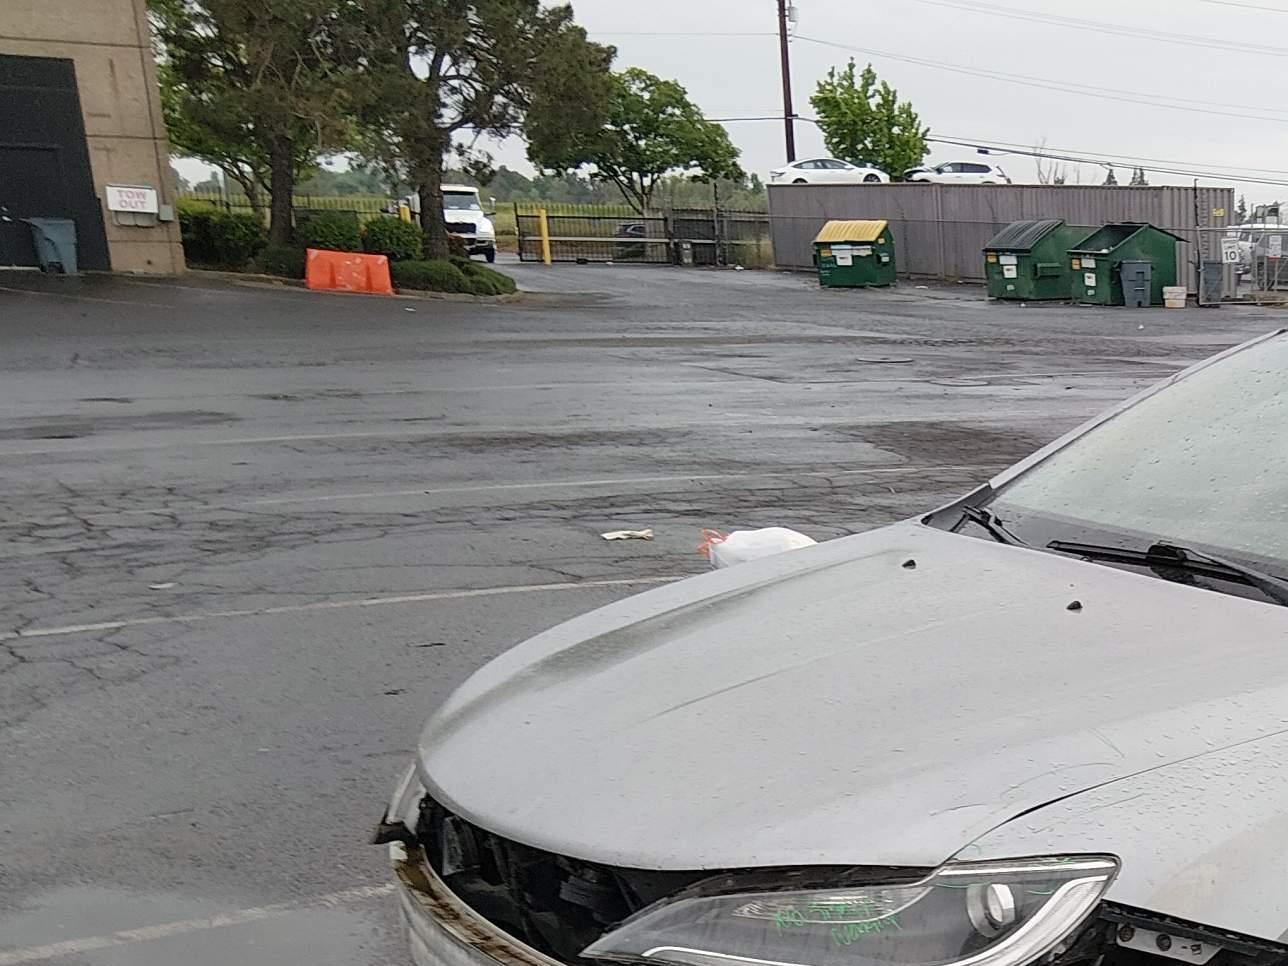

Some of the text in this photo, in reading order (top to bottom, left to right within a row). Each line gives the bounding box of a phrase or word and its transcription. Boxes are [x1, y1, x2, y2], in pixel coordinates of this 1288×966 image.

[116, 190, 147, 200] TOW
[119, 199, 147, 209] OUT
[1224, 251, 1237, 261] 10
